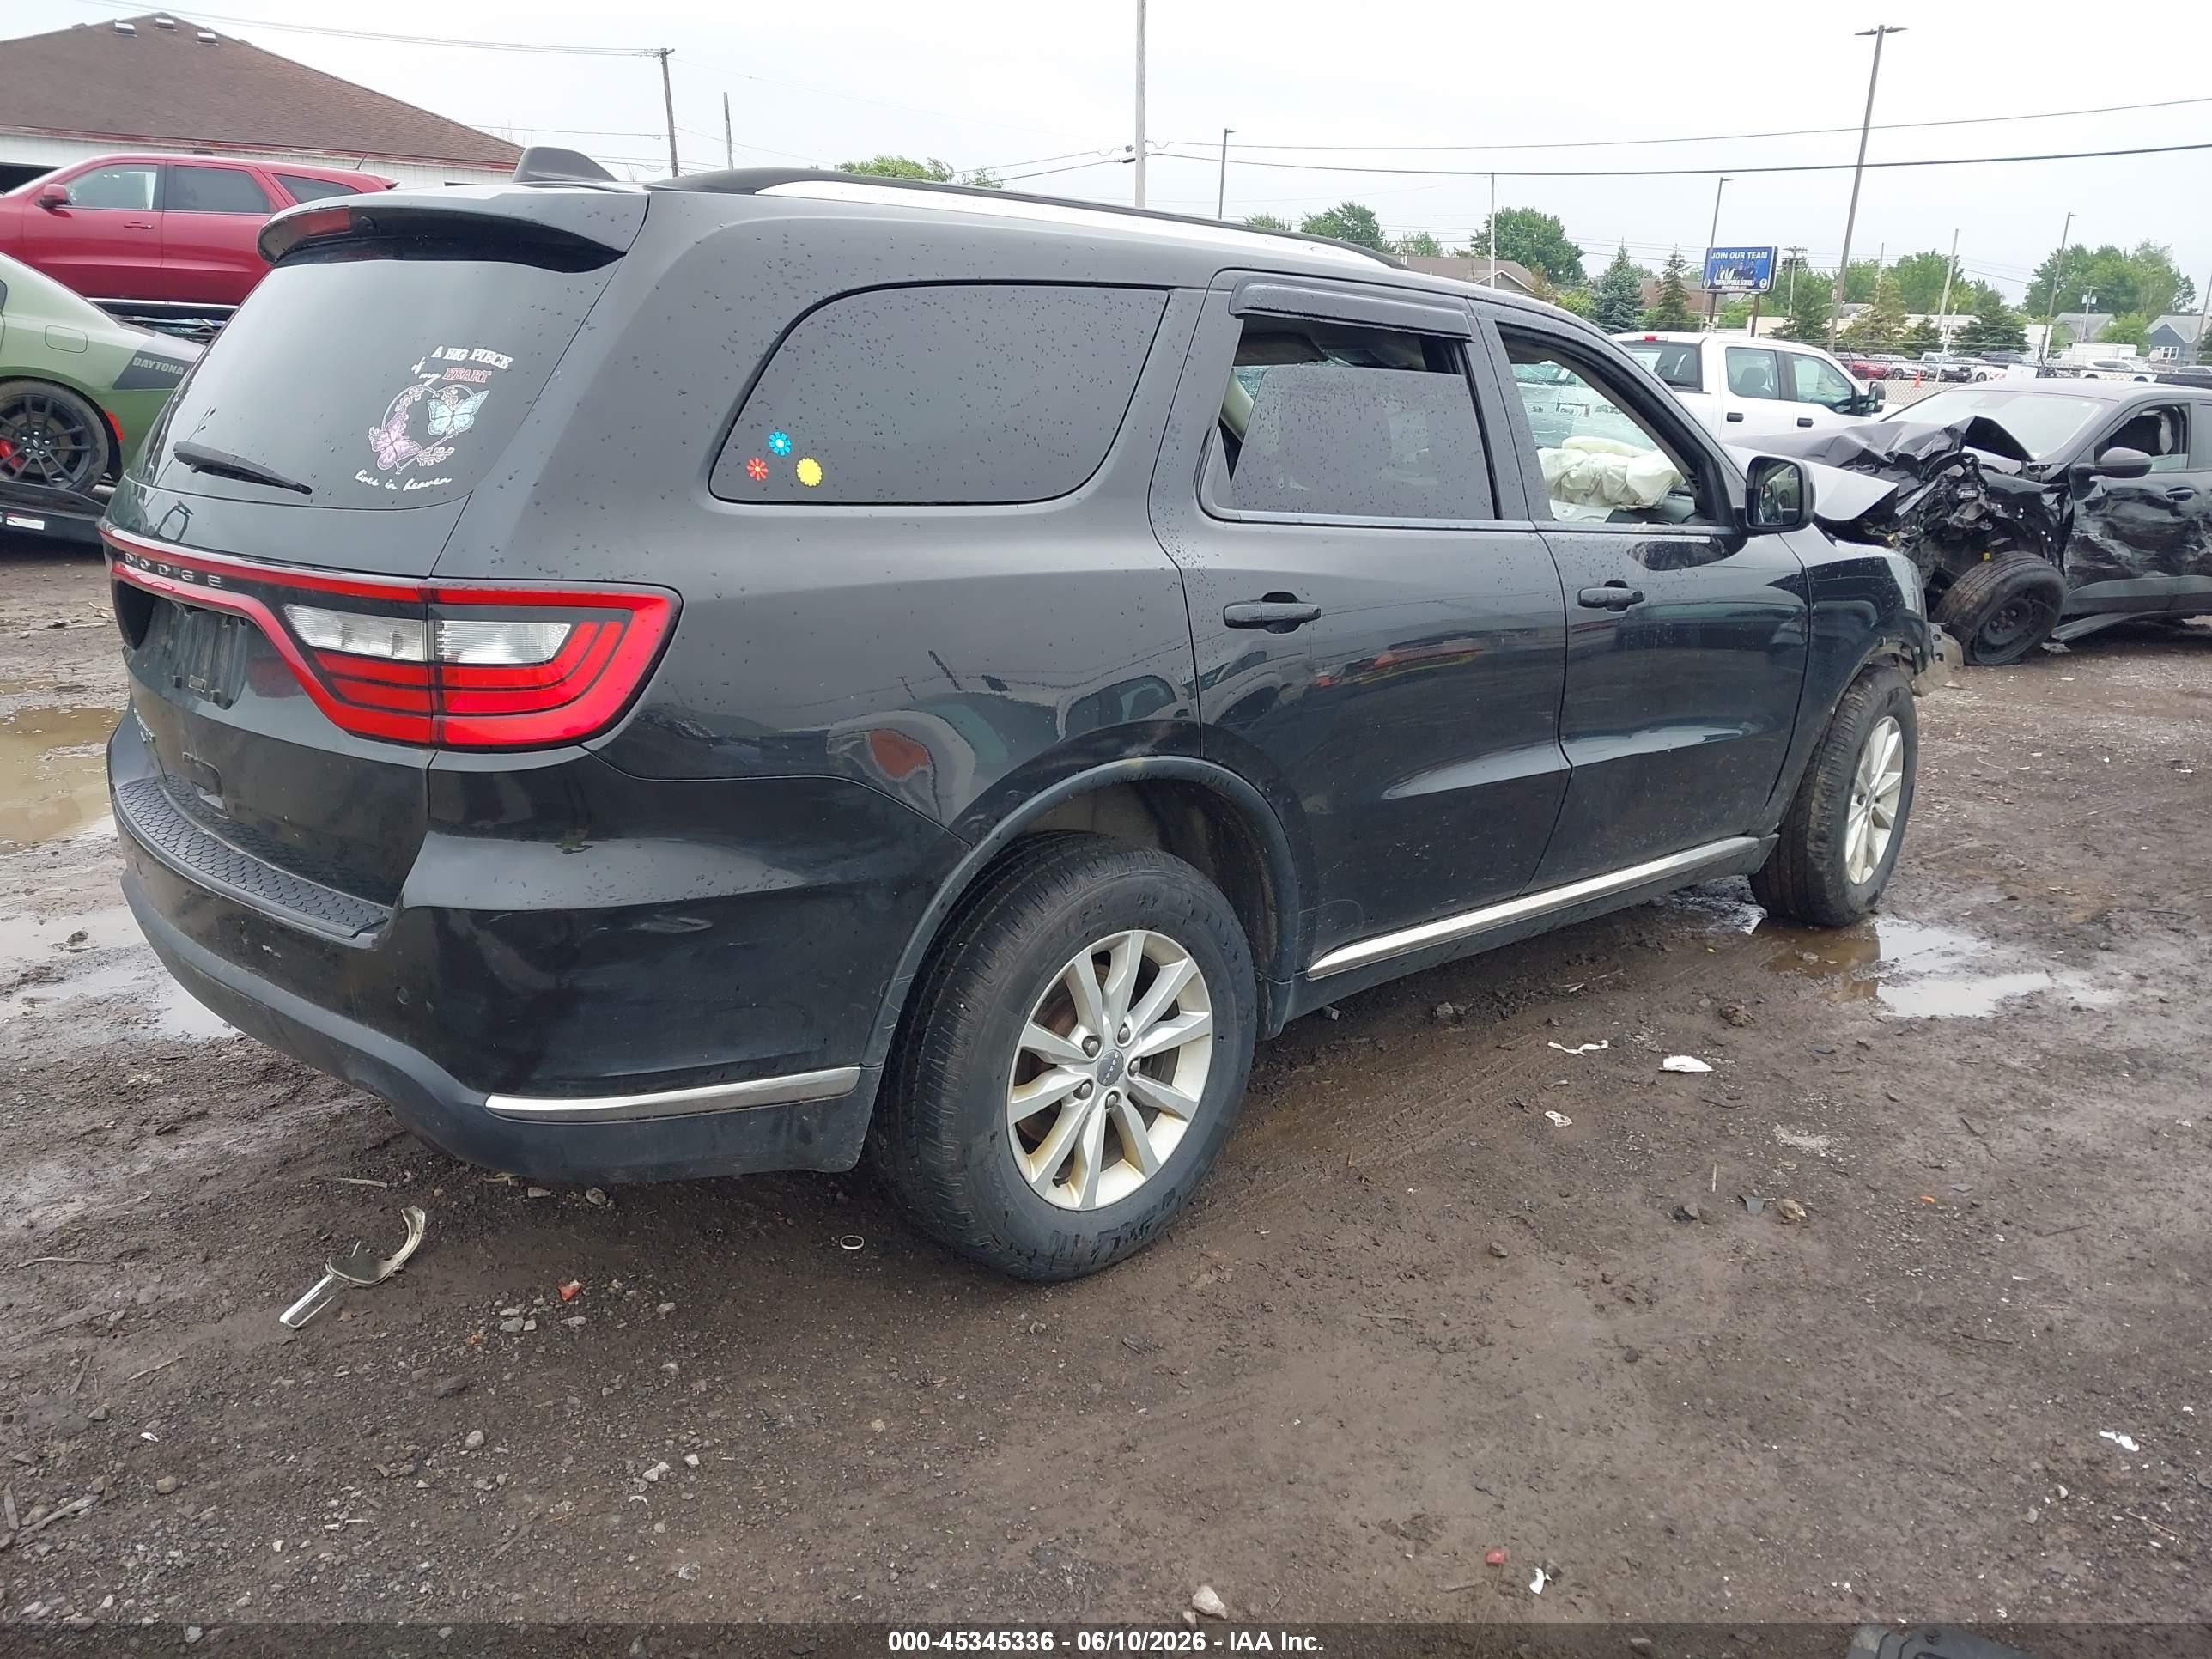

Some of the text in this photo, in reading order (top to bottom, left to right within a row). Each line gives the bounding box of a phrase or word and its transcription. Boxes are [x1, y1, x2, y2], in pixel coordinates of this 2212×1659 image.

[1711, 251, 1768, 259] JOIN OUR TEAM
[132, 356, 185, 375] DAYTONA
[411, 356, 426, 374] of
[430, 345, 443, 358] A
[469, 348, 514, 369] PIECE
[441, 367, 492, 383] HEART
[355, 469, 453, 492] lives in heaven
[125, 552, 222, 588] DODGE
